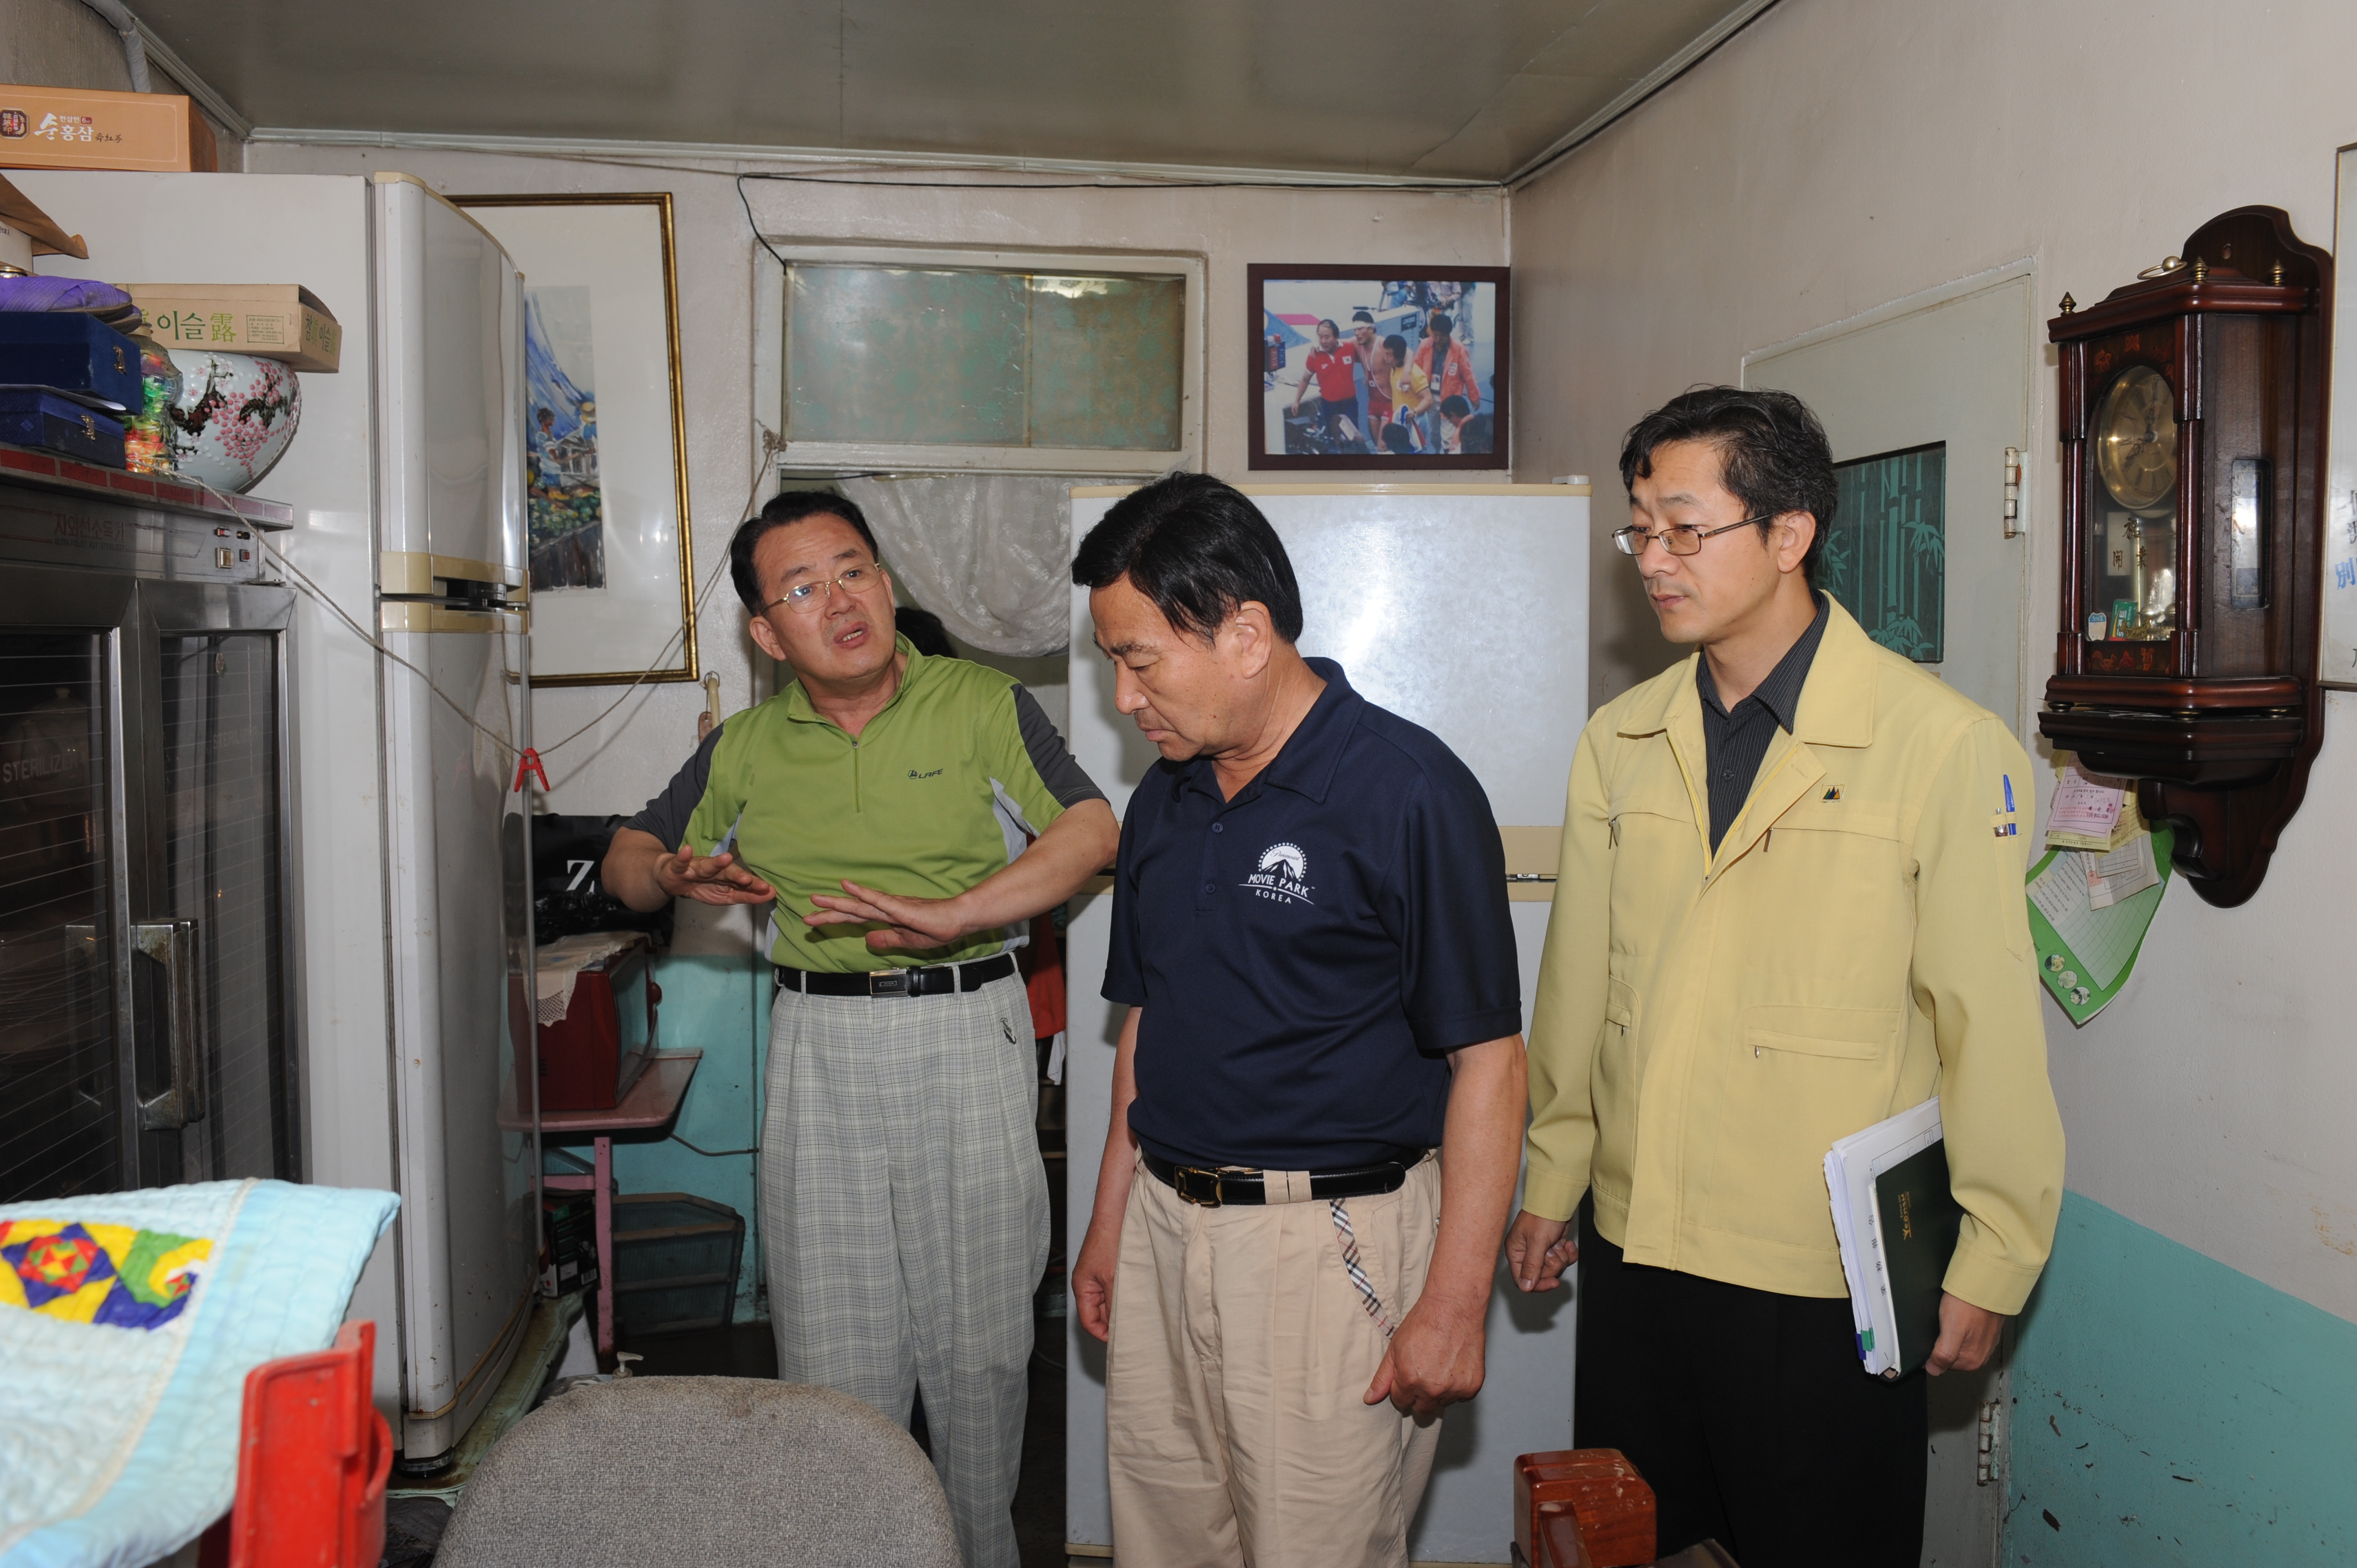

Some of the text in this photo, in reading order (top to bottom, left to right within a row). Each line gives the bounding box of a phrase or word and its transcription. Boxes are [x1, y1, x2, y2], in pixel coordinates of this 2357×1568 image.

[54, 513, 125, 543] 자외선소독기
[3, 752, 78, 783] STERILIZER
[1270, 849, 1300, 861] Paramount
[1248, 874, 1309, 898] MOVIE PARK
[1255, 889, 1291, 904] KOREA
